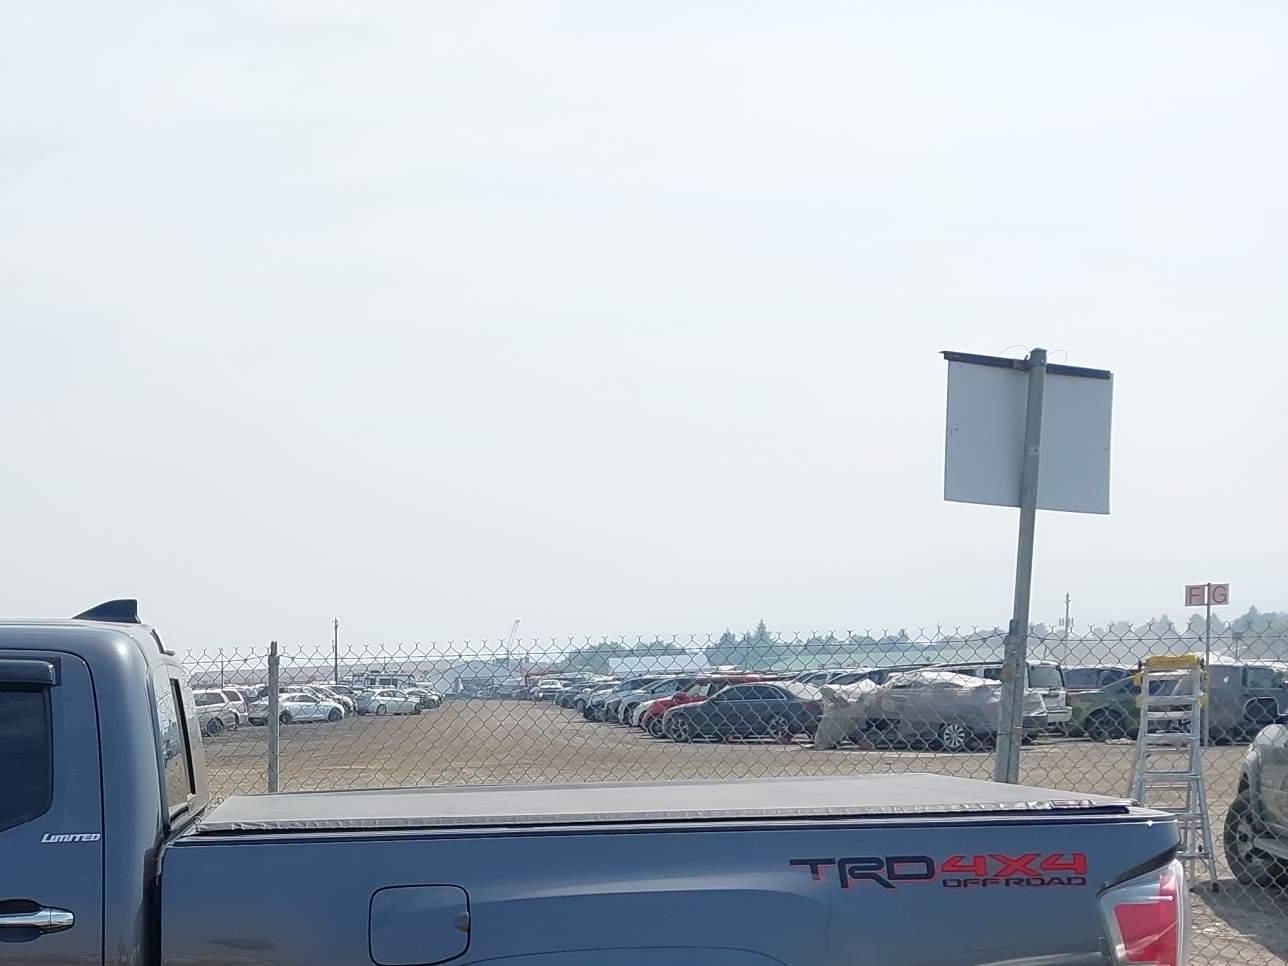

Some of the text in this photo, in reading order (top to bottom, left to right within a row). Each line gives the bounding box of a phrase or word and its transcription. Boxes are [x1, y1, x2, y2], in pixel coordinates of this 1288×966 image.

[1188, 585, 1227, 604] F G
[789, 855, 937, 889] TRD
[941, 876, 1087, 889] OFF ROAD
